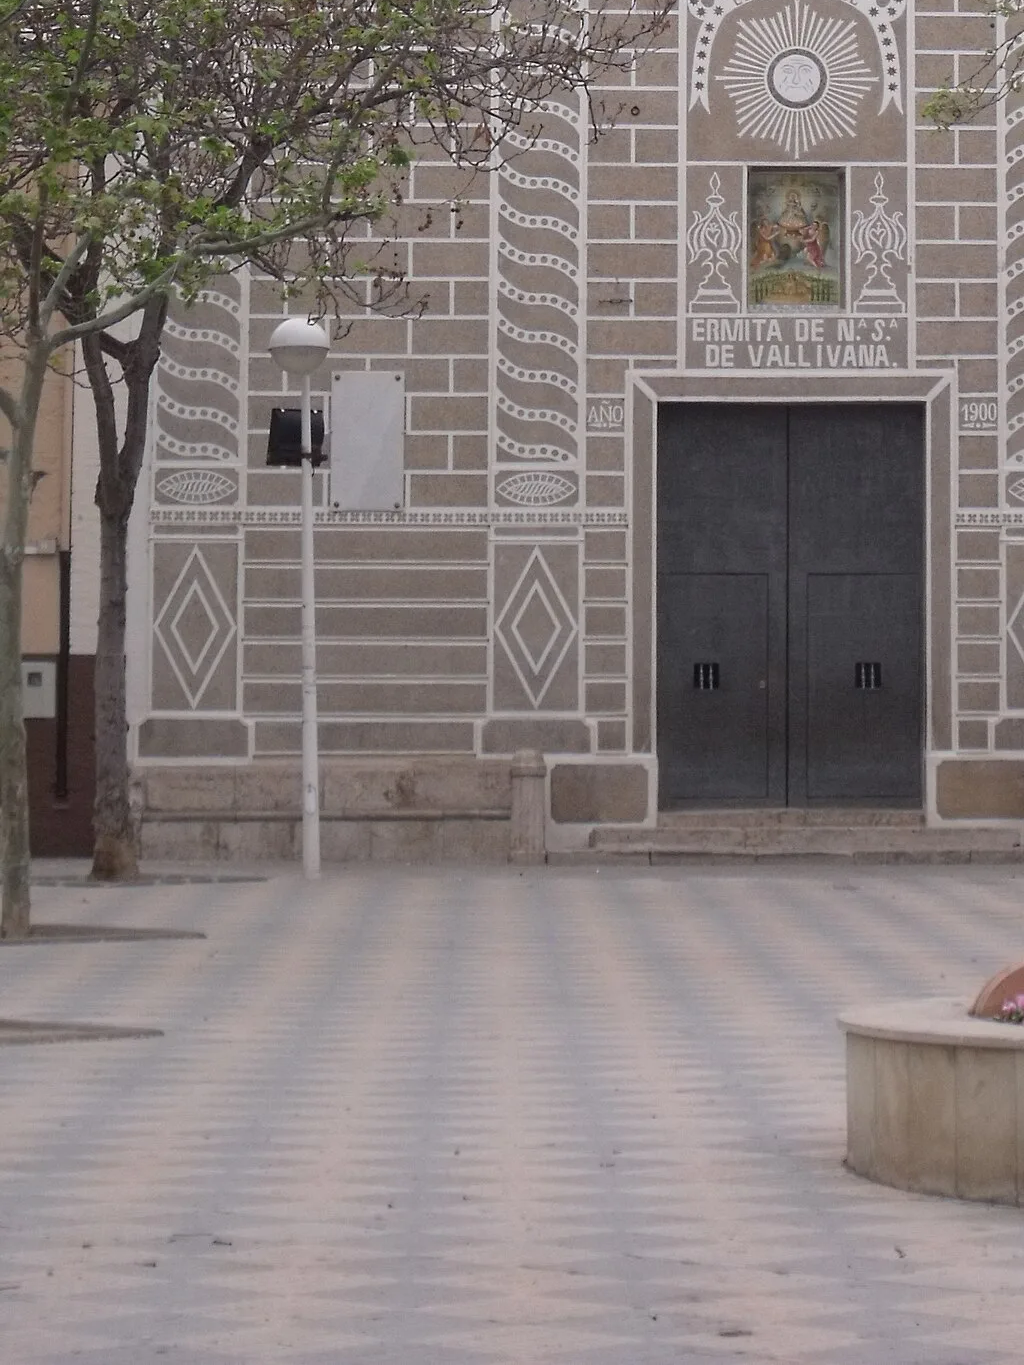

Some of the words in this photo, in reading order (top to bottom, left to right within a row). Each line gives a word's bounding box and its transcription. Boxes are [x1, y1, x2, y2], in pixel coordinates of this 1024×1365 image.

[692, 319, 782, 342] ERMITA
[795, 319, 824, 342] DE
[705, 345, 734, 367] DE
[748, 345, 898, 368] VALLIVANA.
[587, 400, 624, 423] AÑO
[961, 402, 997, 421] 1900
